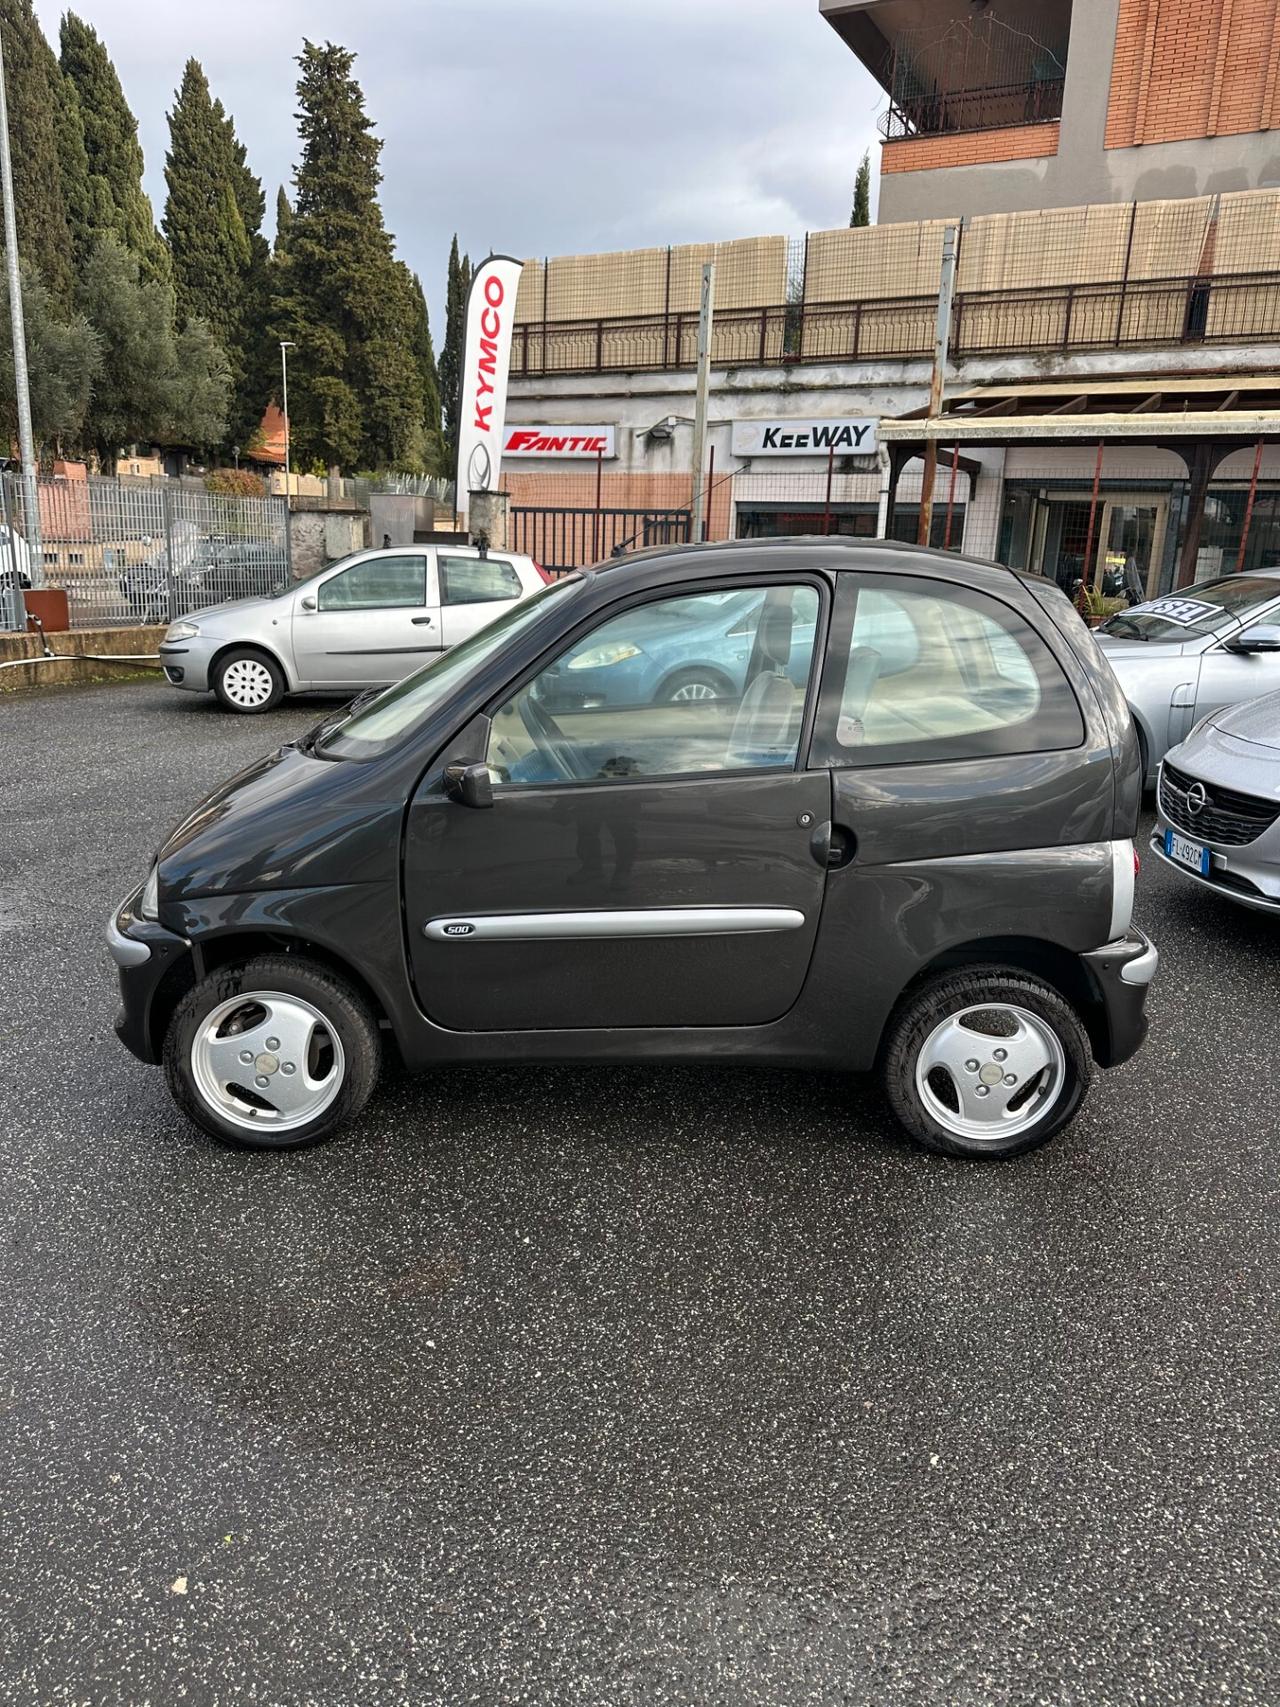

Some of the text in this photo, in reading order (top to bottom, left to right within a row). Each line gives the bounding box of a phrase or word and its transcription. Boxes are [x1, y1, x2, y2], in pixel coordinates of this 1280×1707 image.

[474, 275, 504, 432] KYMCO
[504, 431, 607, 451] FANTIC
[762, 425, 871, 448] KEEWAY
[1127, 600, 1207, 621] ESEL
[447, 925, 470, 934] 500
